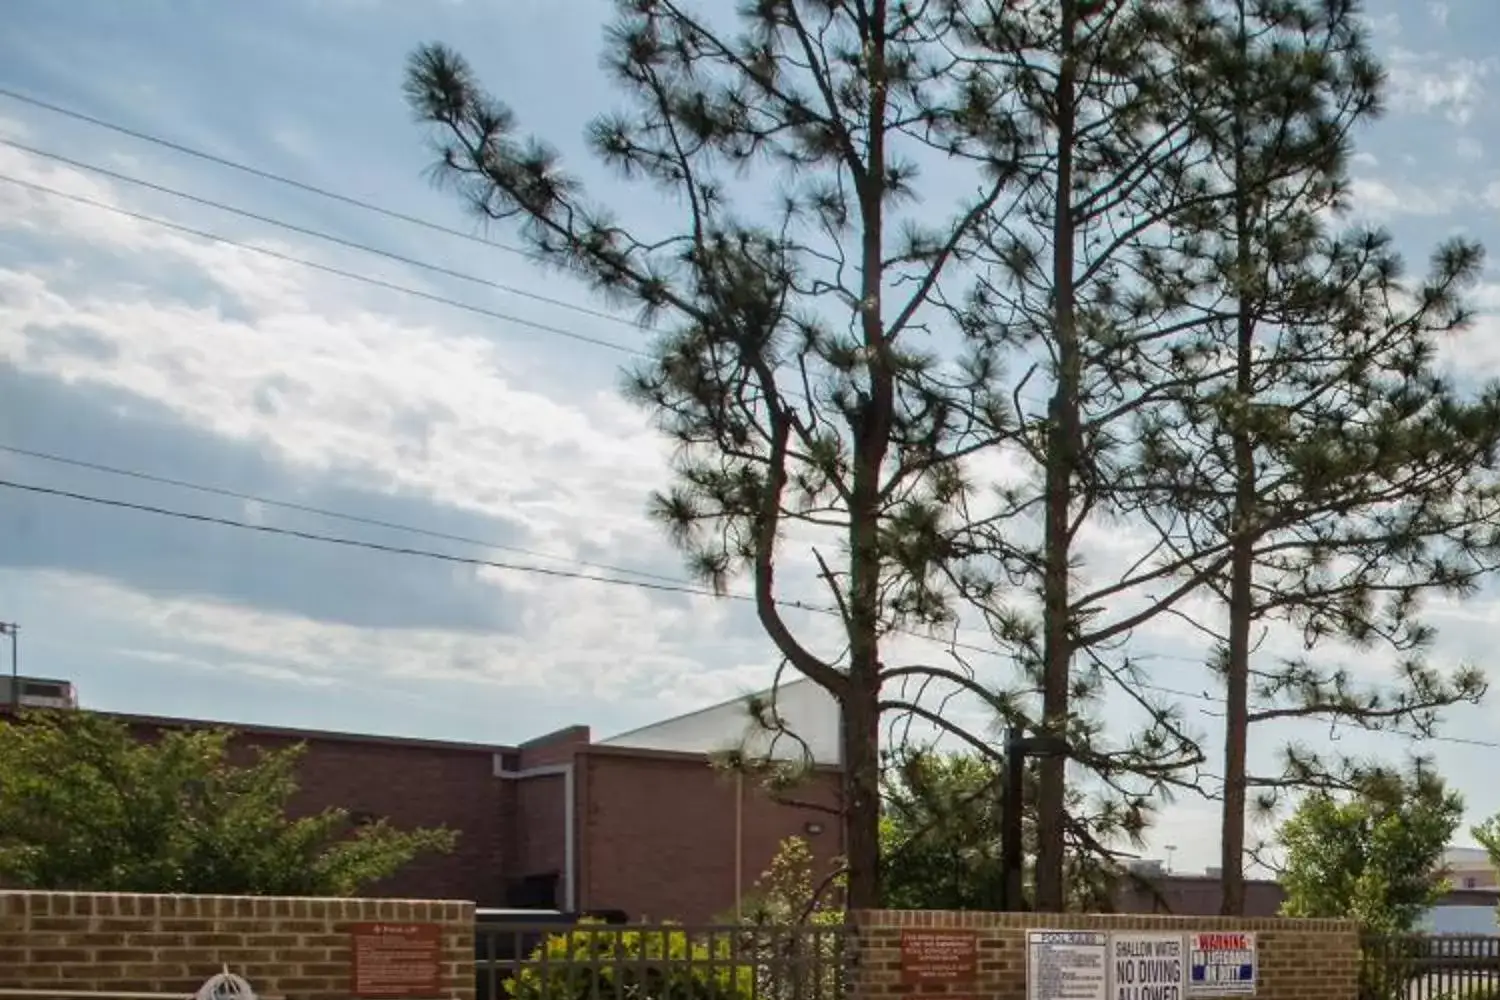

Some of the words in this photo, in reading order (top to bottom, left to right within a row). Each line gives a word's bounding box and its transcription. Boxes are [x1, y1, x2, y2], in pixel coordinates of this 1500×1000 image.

[1116, 941, 1153, 957] SHALLOW
[1155, 941, 1181, 957] WATER
[1199, 933, 1249, 949] WARNING
[1117, 960, 1135, 984] NO
[1139, 959, 1181, 984] DIVING
